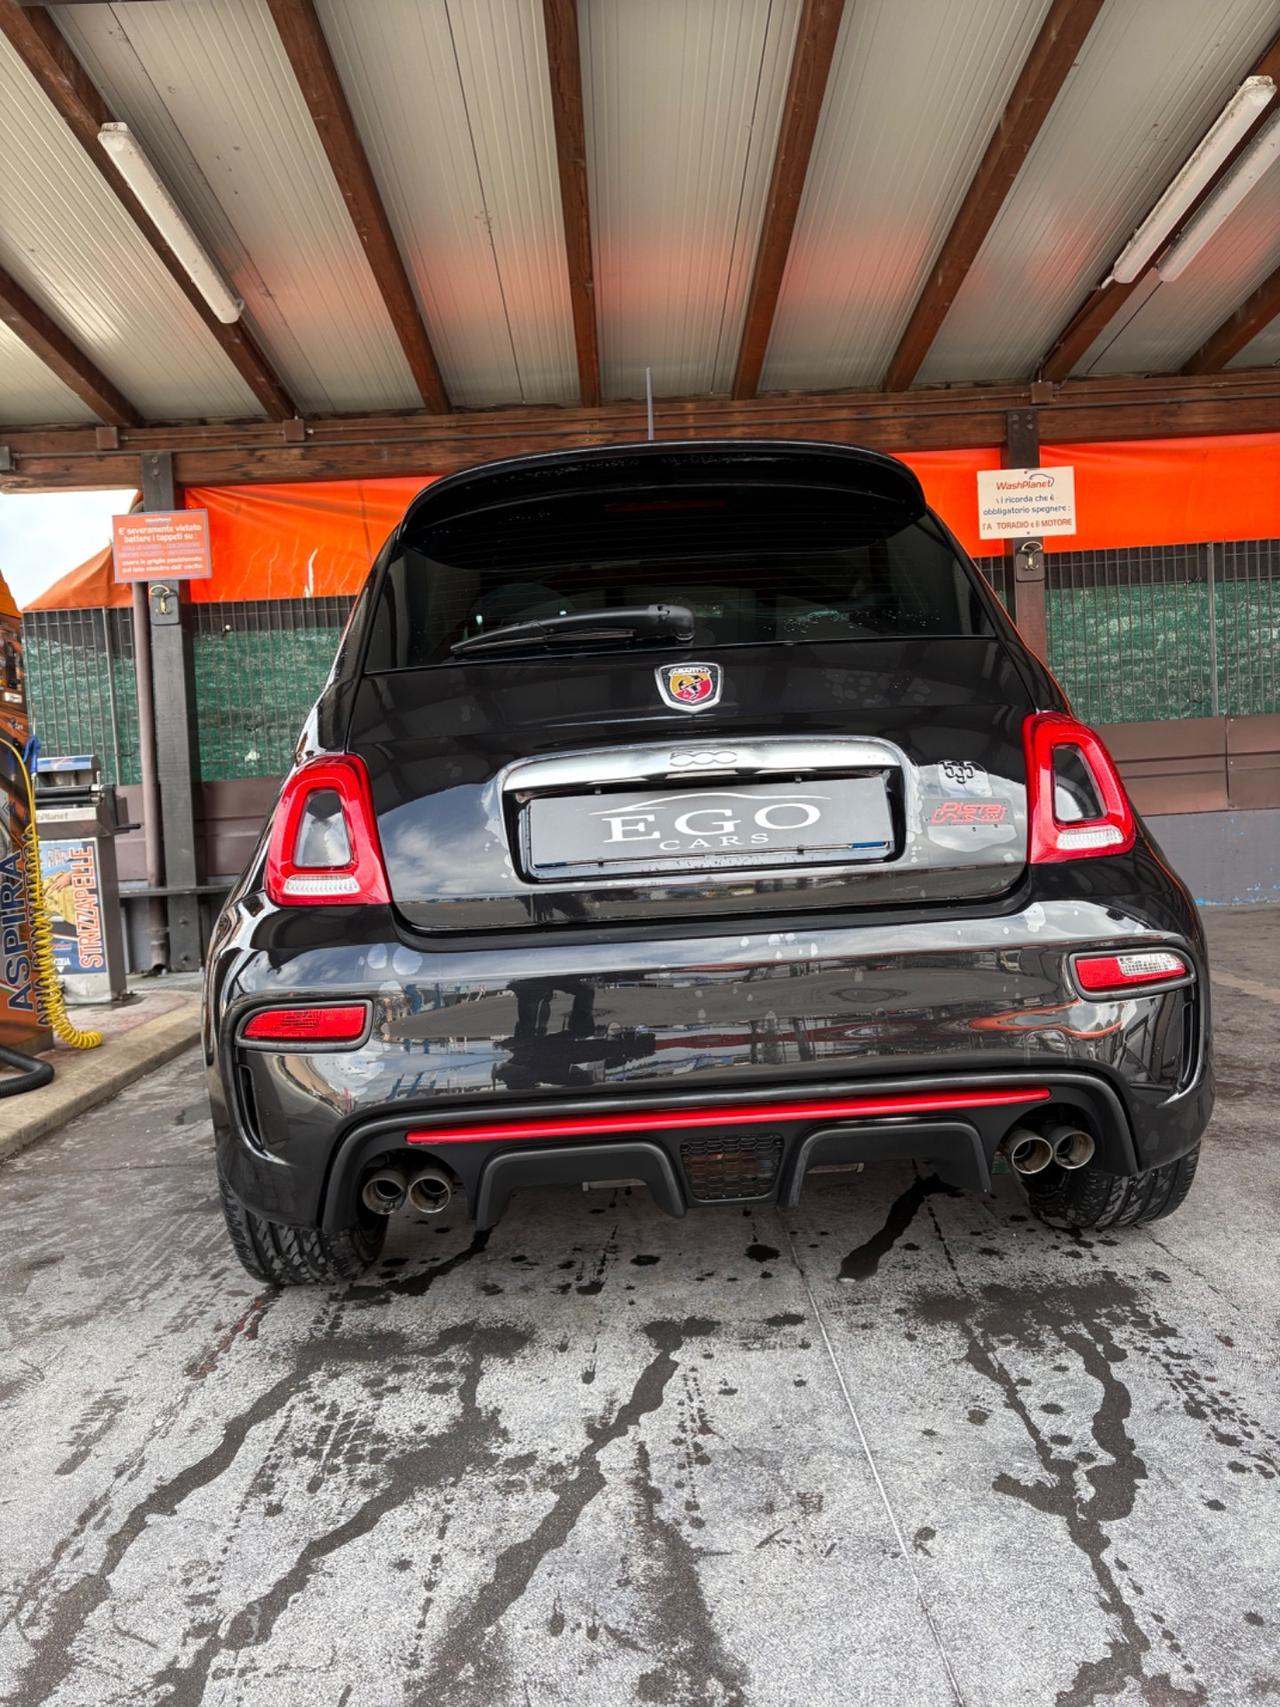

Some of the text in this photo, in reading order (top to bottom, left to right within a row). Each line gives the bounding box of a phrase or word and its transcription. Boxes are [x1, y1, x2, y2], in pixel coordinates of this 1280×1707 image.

[996, 480, 1051, 490] WashPlanet
[1035, 494, 1048, 502] che
[983, 506, 1030, 516] obbligatorio
[1032, 505, 1066, 514] spegnere
[1041, 518, 1072, 528] MOTORE
[602, 803, 821, 843] EGO
[659, 833, 769, 850] CARS
[69, 845, 104, 969] STRIZZAPELLE
[1, 850, 34, 1012] ASPIRA
